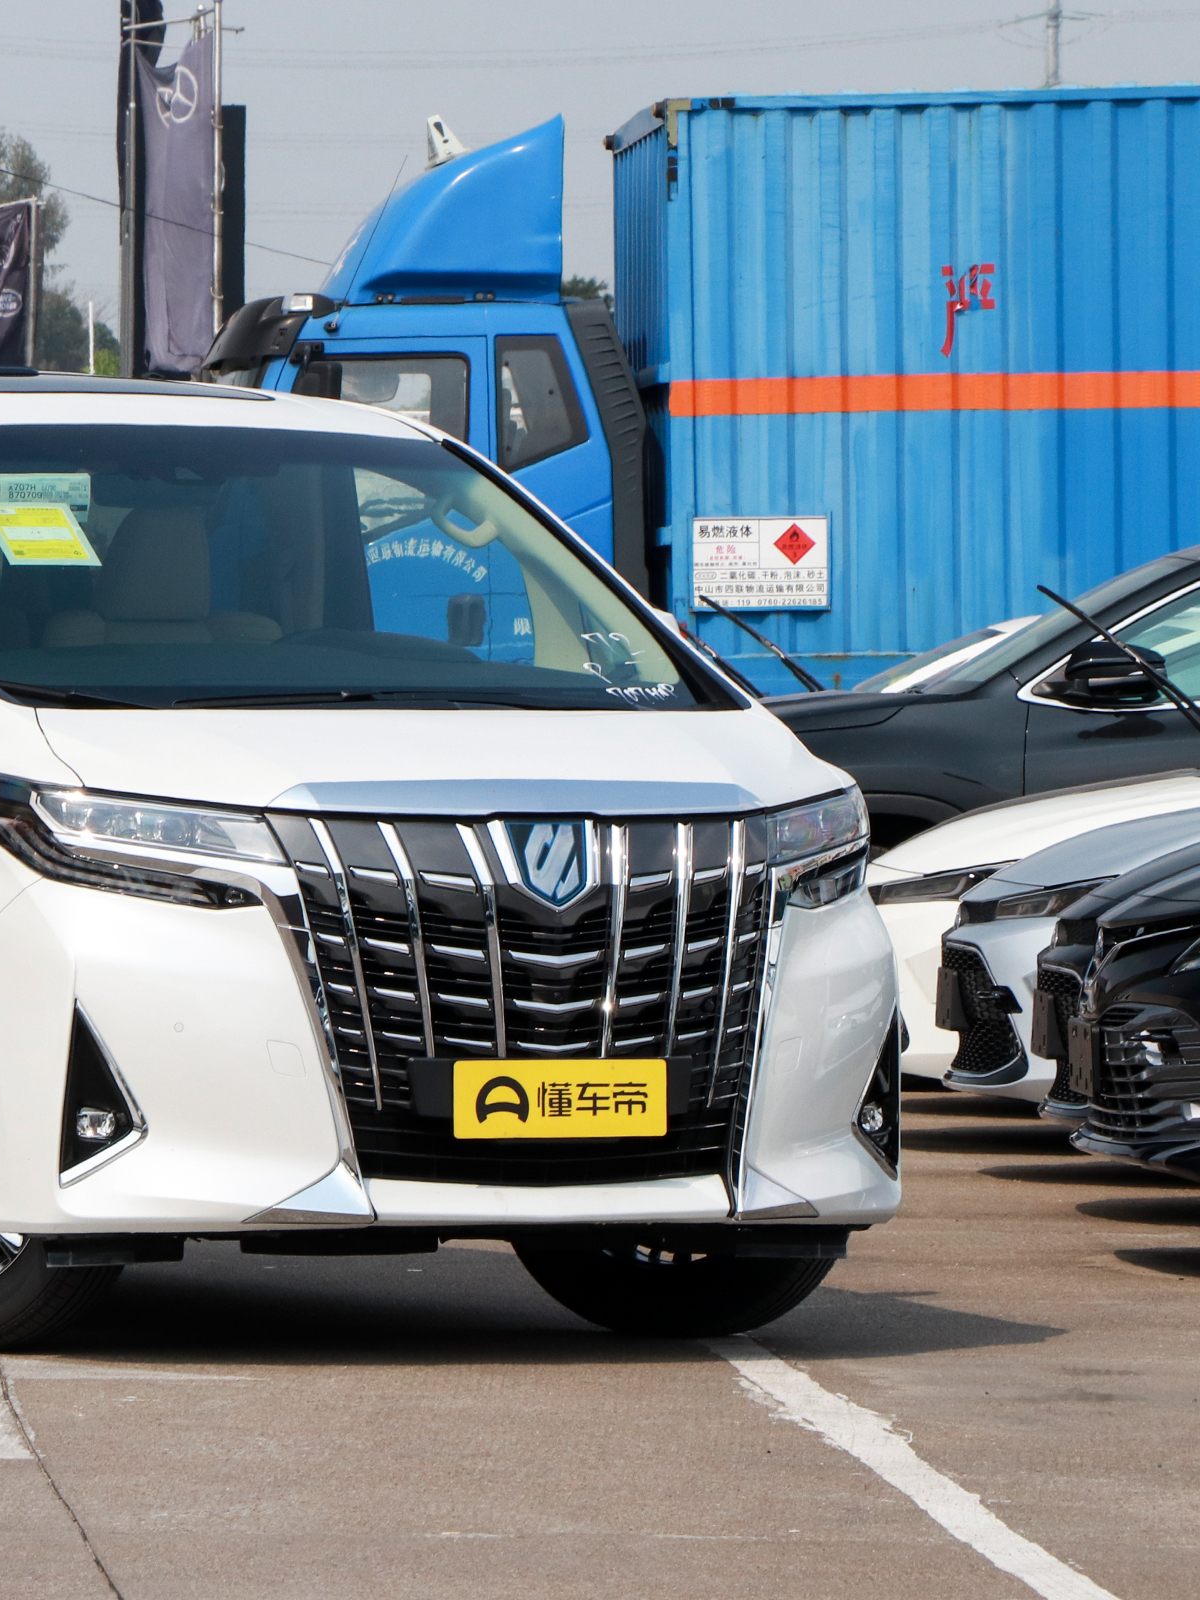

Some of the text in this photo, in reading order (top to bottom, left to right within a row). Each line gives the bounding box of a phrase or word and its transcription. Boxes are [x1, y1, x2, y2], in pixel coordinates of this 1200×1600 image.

[698, 525, 753, 538] 易燃液体
[715, 545, 736, 554] 危险
[366, 537, 489, 583] 四联物流运输有限公司
[694, 583, 825, 595] 中山市四联物流运输有限公司
[537, 1081, 649, 1118] 懂车帝
